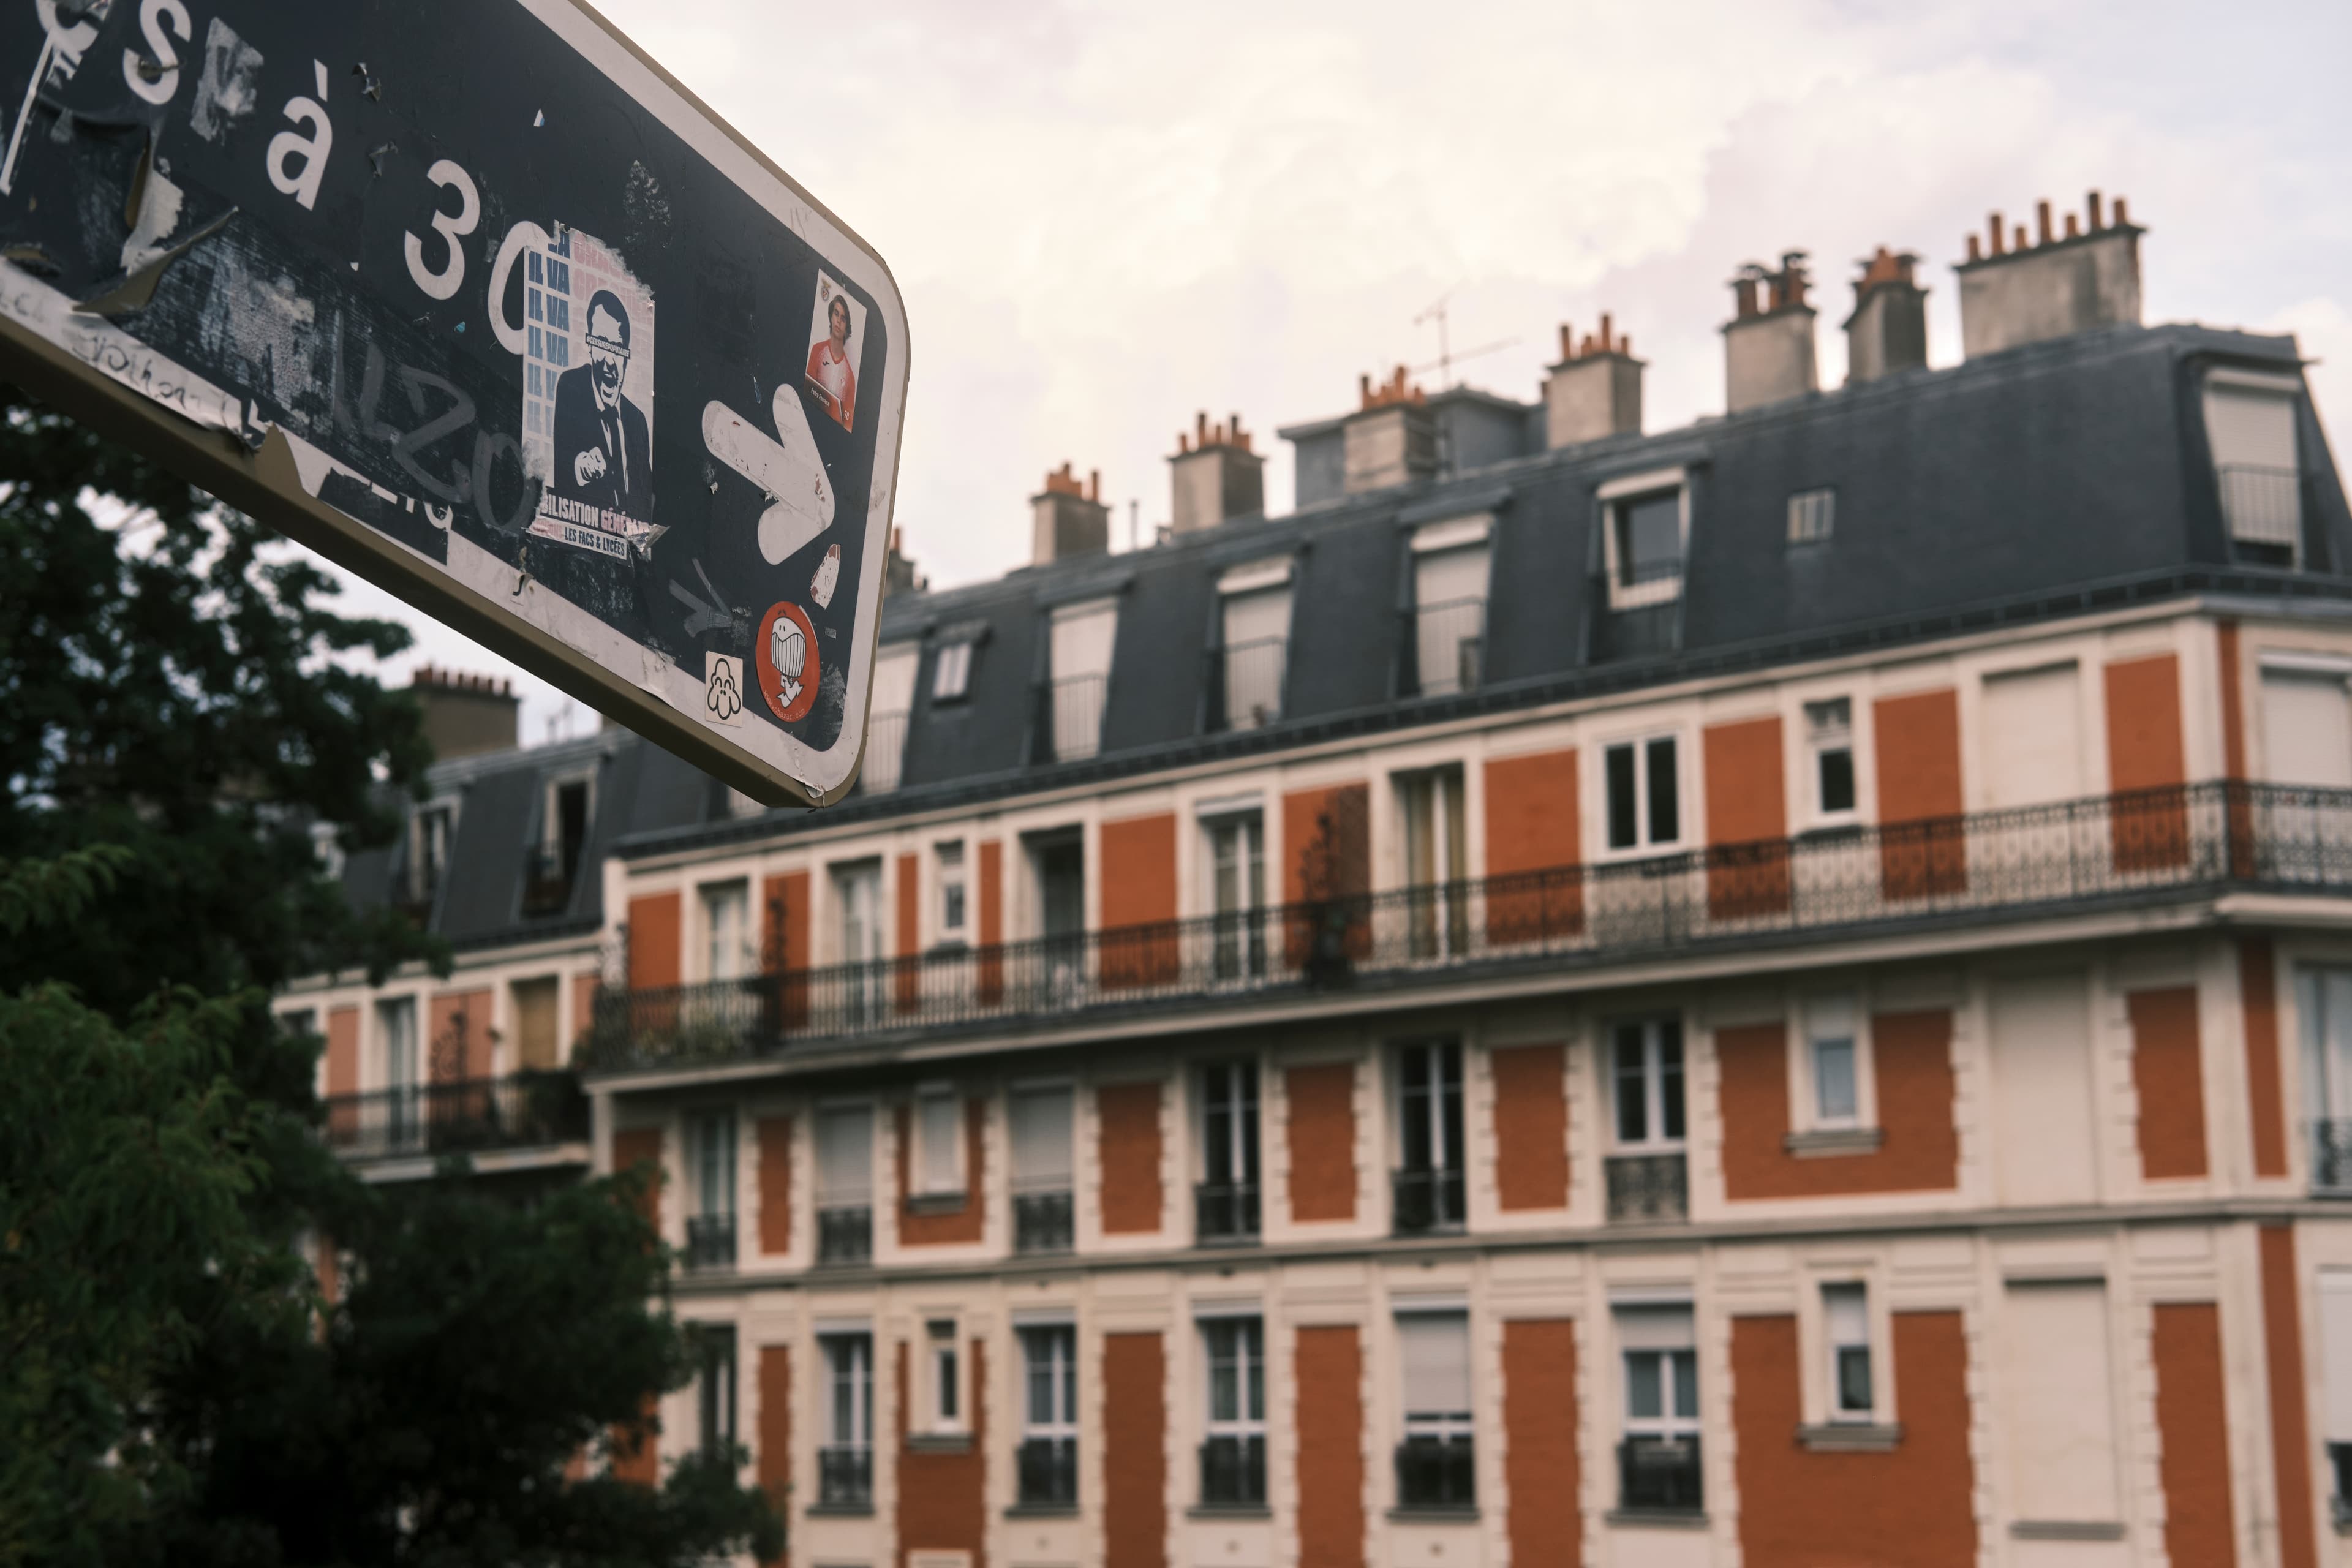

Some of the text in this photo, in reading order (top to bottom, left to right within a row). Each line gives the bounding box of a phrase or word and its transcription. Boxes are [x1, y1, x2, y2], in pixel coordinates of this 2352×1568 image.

[266, 59, 333, 211] à
[529, 250, 570, 295] IL VA
[528, 287, 543, 323] IL
[546, 294, 570, 333] VA
[527, 324, 569, 367] IL VA
[565, 526, 576, 543] LES
[578, 530, 594, 548] FACS
[595, 535, 601, 548] &
[603, 535, 625, 557] LYCÉES
